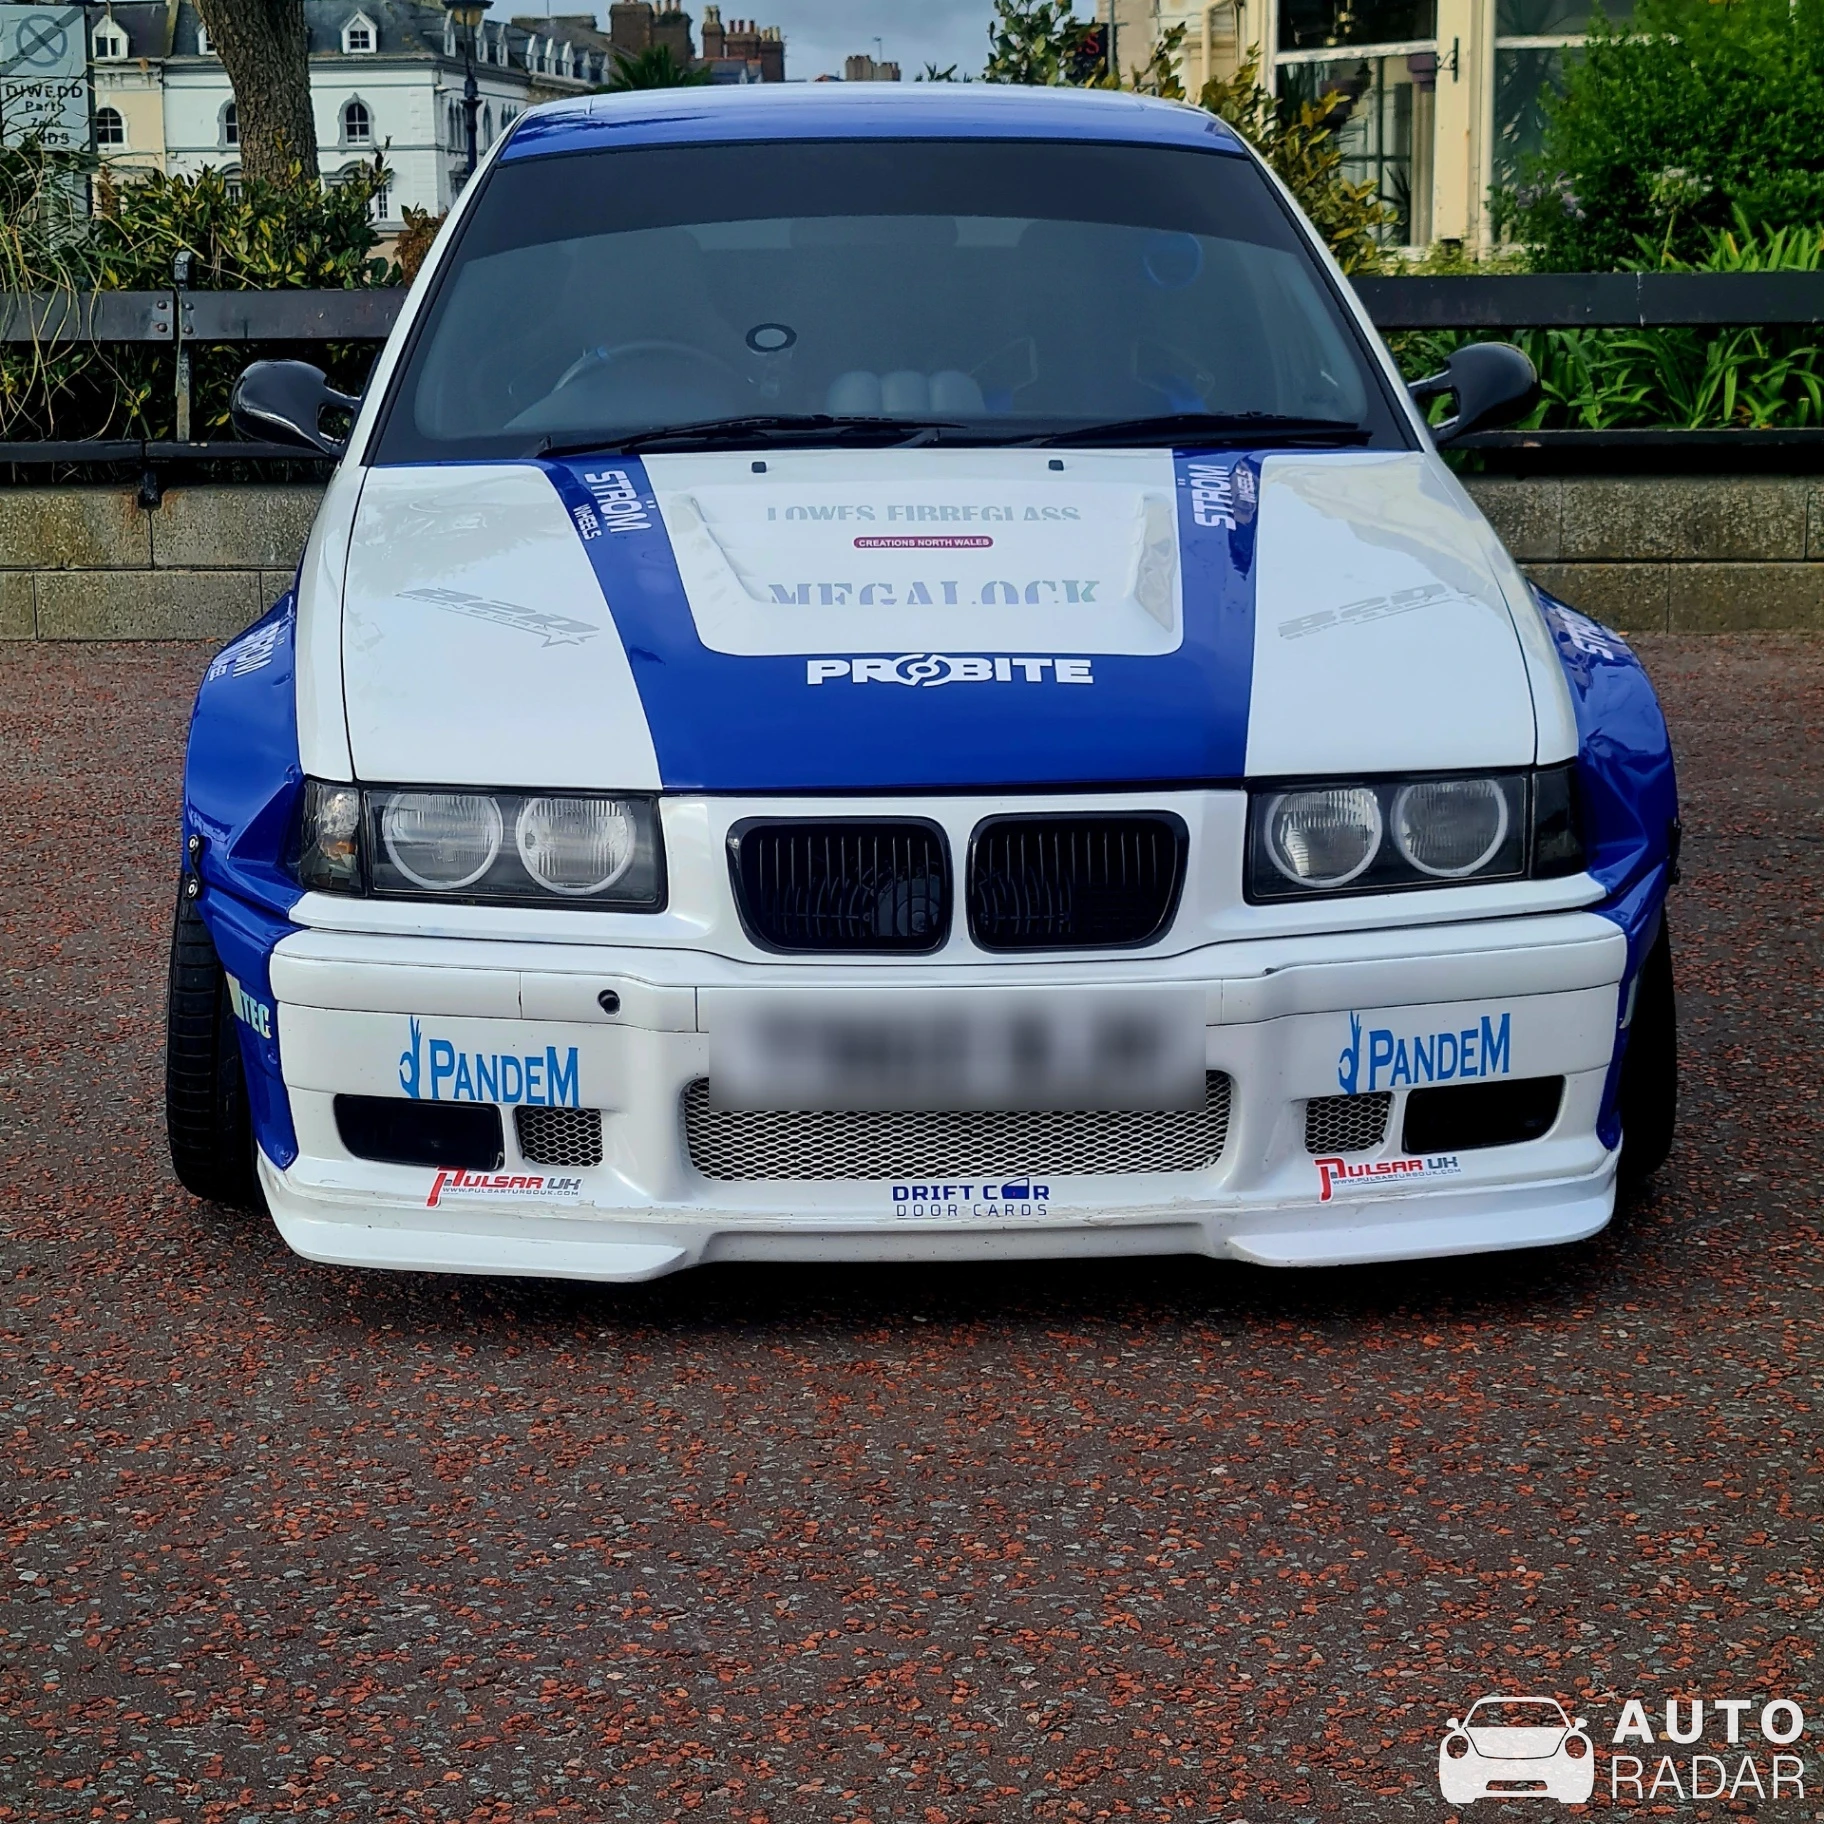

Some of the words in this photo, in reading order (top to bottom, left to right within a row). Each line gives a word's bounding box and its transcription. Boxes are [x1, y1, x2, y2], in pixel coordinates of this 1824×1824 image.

[6, 84, 83, 98] DIWEDD
[1235, 466, 1257, 504] WHEELS
[573, 503, 602, 541] WHEELS
[858, 539, 916, 547] CREATIONS
[917, 539, 953, 547] NORTH
[954, 538, 990, 546] WALES
[767, 580, 1101, 605] MEGALOCK
[806, 653, 1095, 687] PROBITE
[426, 1166, 545, 1207] PULSAR
[547, 1177, 582, 1190] UK
[892, 1185, 974, 1201] DRIFT
[1314, 1157, 1423, 1201] PULSAR
[1427, 1156, 1458, 1169] UK
[896, 1204, 958, 1217] DOOR
[973, 1203, 1048, 1217] CARDS
